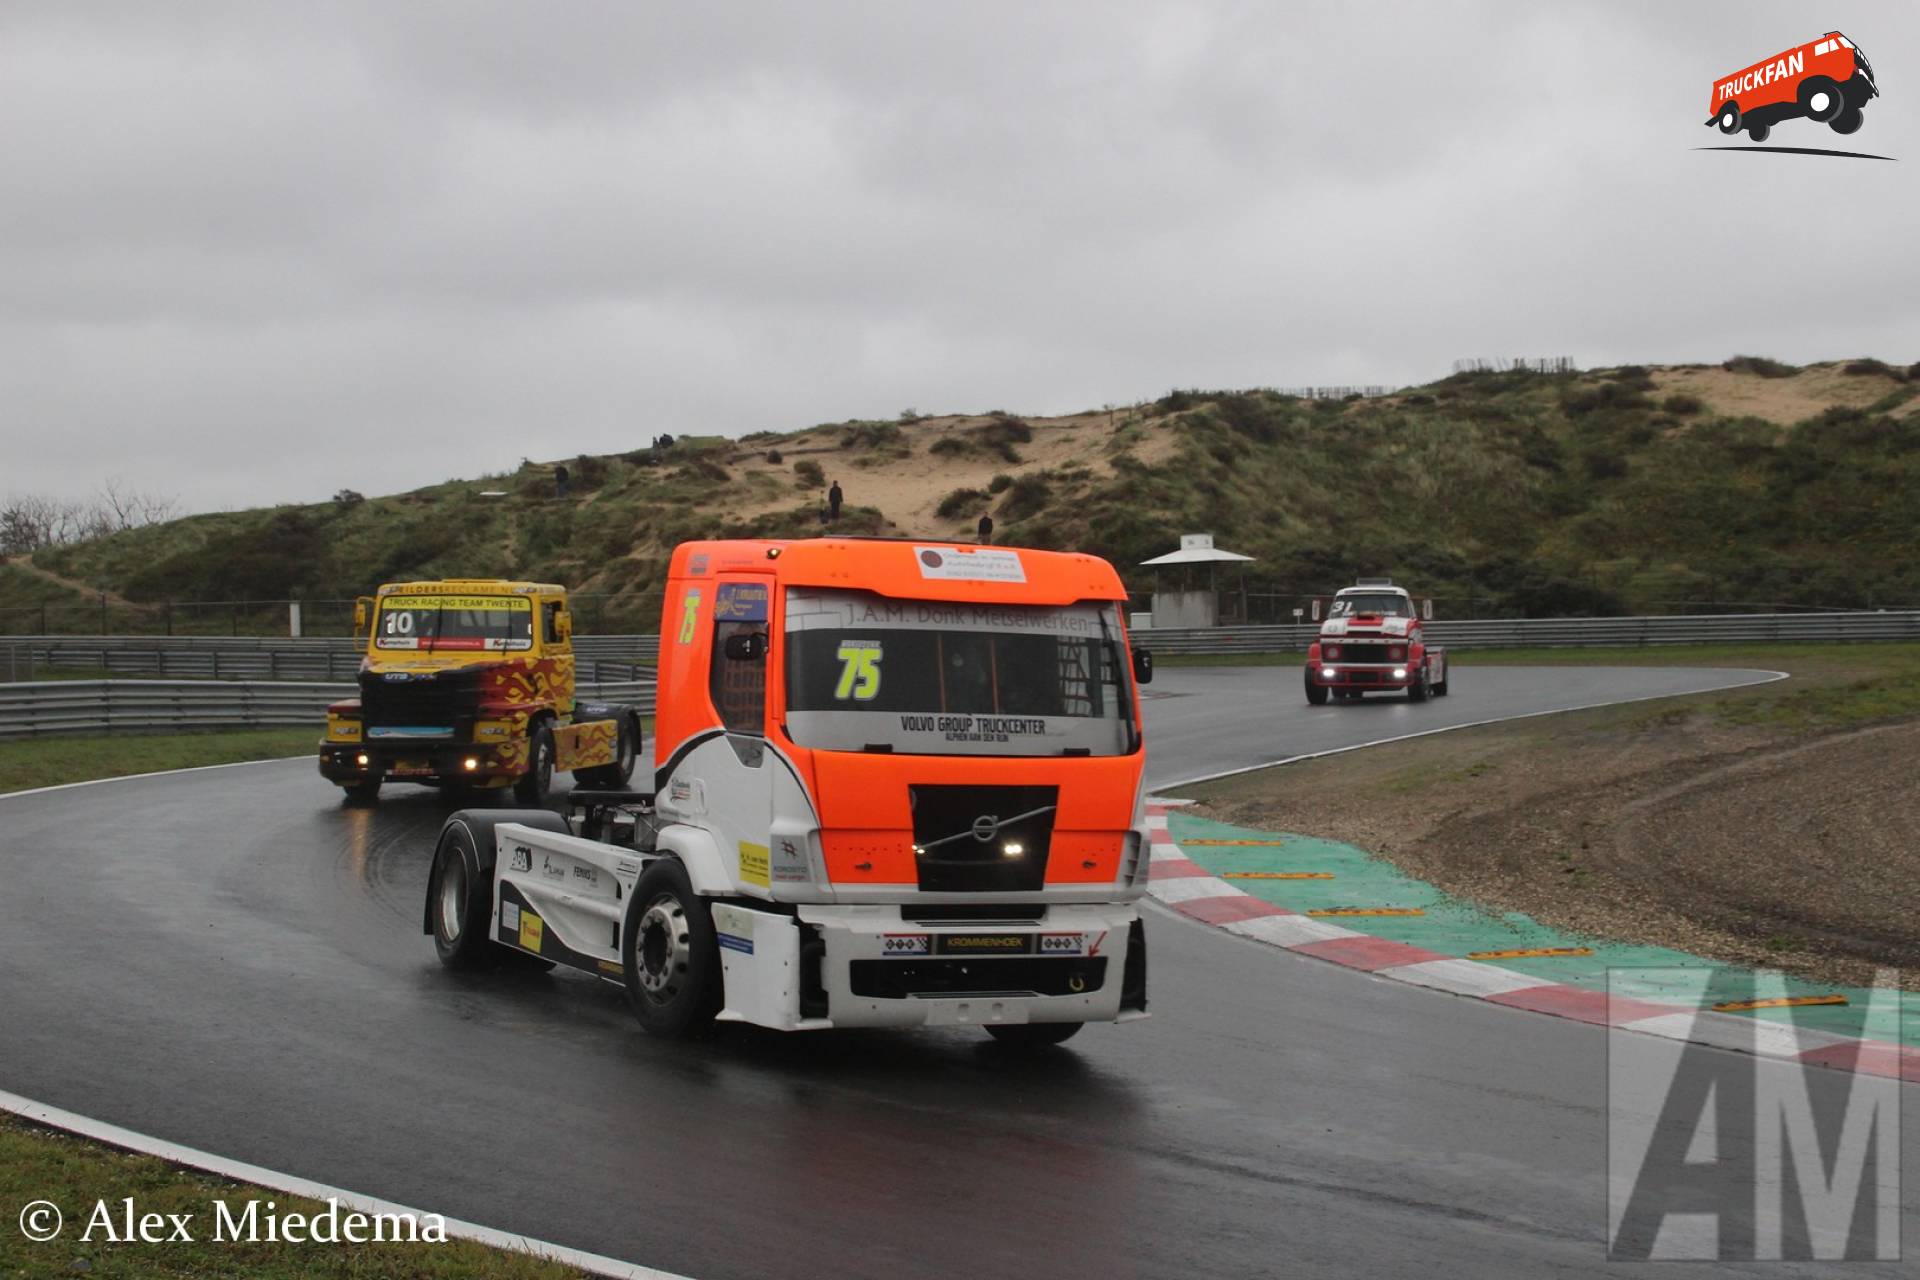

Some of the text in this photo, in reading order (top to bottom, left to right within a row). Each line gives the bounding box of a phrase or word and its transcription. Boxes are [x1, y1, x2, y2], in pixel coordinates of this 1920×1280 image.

[388, 598, 524, 608] TRUCK RACING TEAM TWENTE
[385, 612, 413, 634] 10
[846, 603, 1088, 632] J.A.M. Donk Metselwerken
[835, 646, 883, 700] 75
[900, 716, 1045, 735] VOLVO GROUP TRUCKCENTER
[947, 937, 1023, 948] KROMMENHOEK
